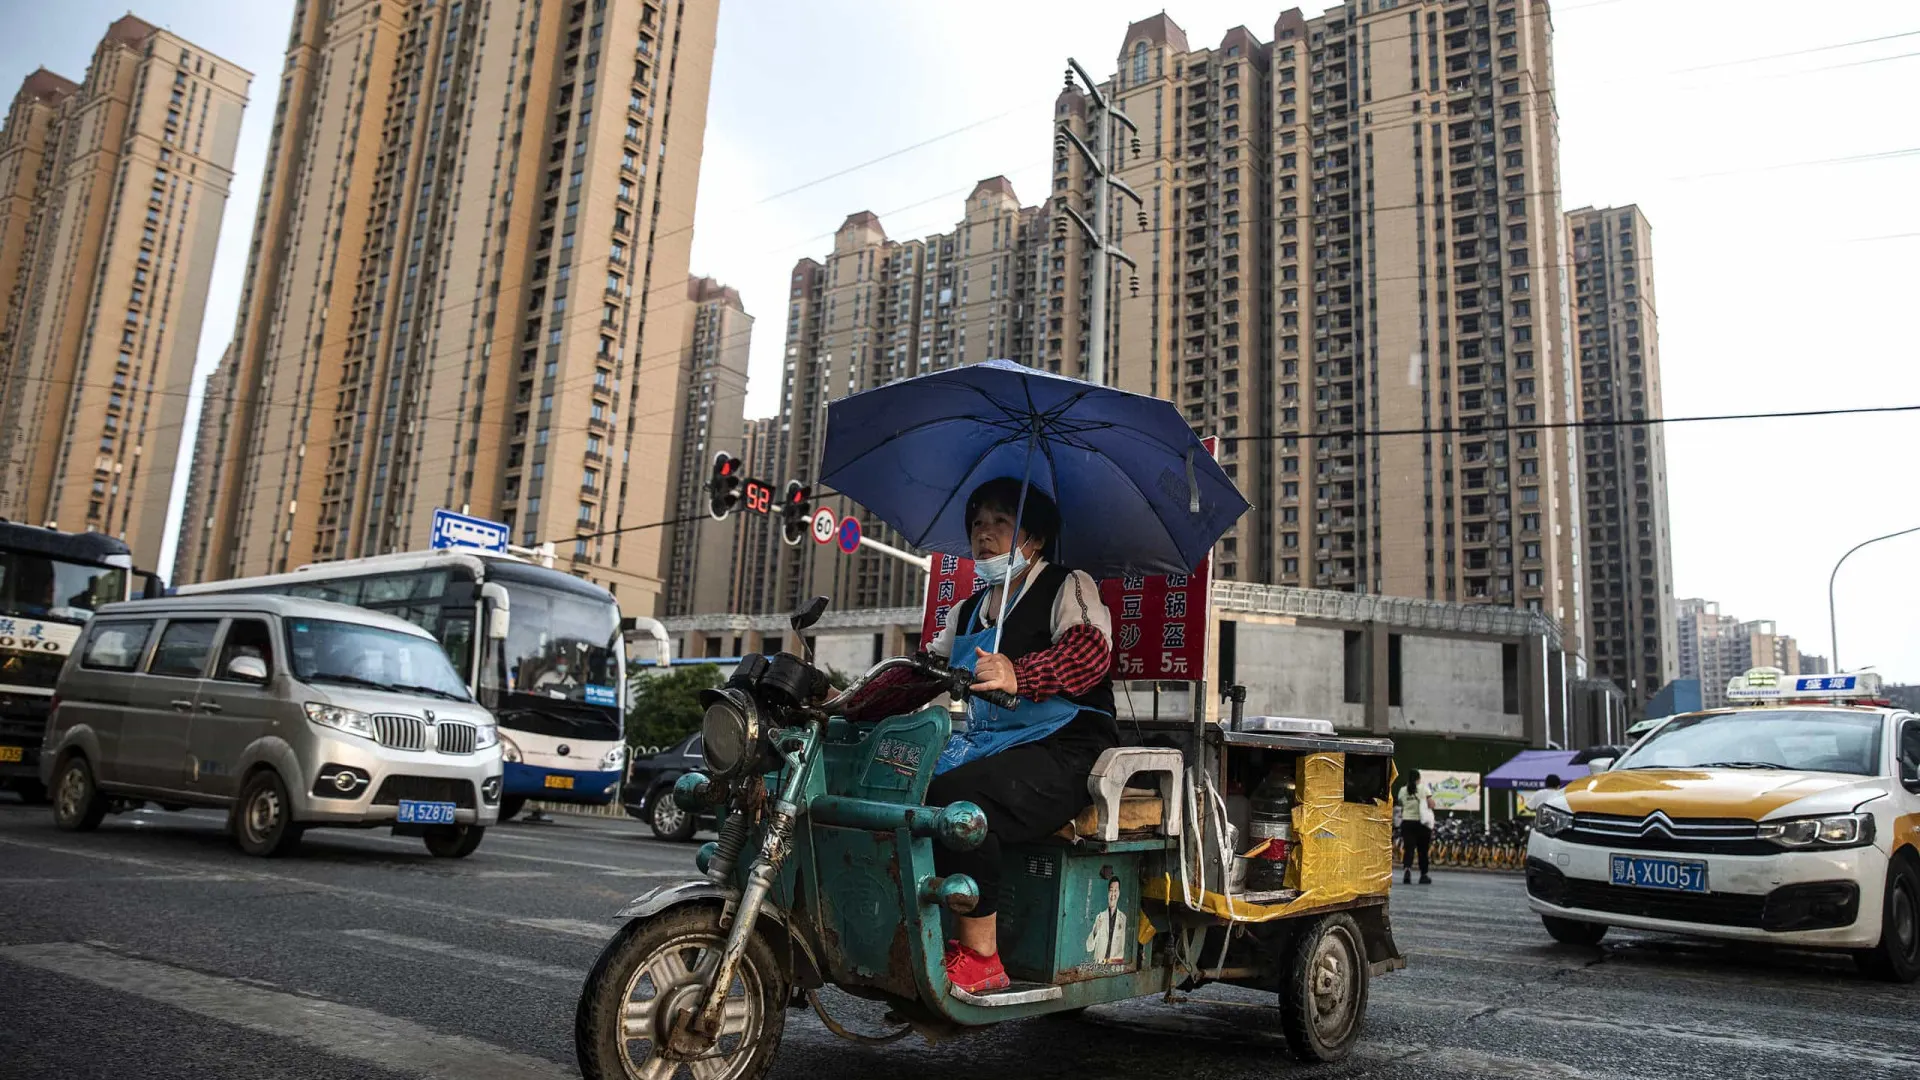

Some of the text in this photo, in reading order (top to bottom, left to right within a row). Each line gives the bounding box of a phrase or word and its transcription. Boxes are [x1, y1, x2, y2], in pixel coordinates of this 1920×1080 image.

[746, 483, 770, 513] 52
[816, 517, 831, 535] 60
[1118, 653, 1144, 673] 5元
[1160, 652, 1187, 673] 5元
